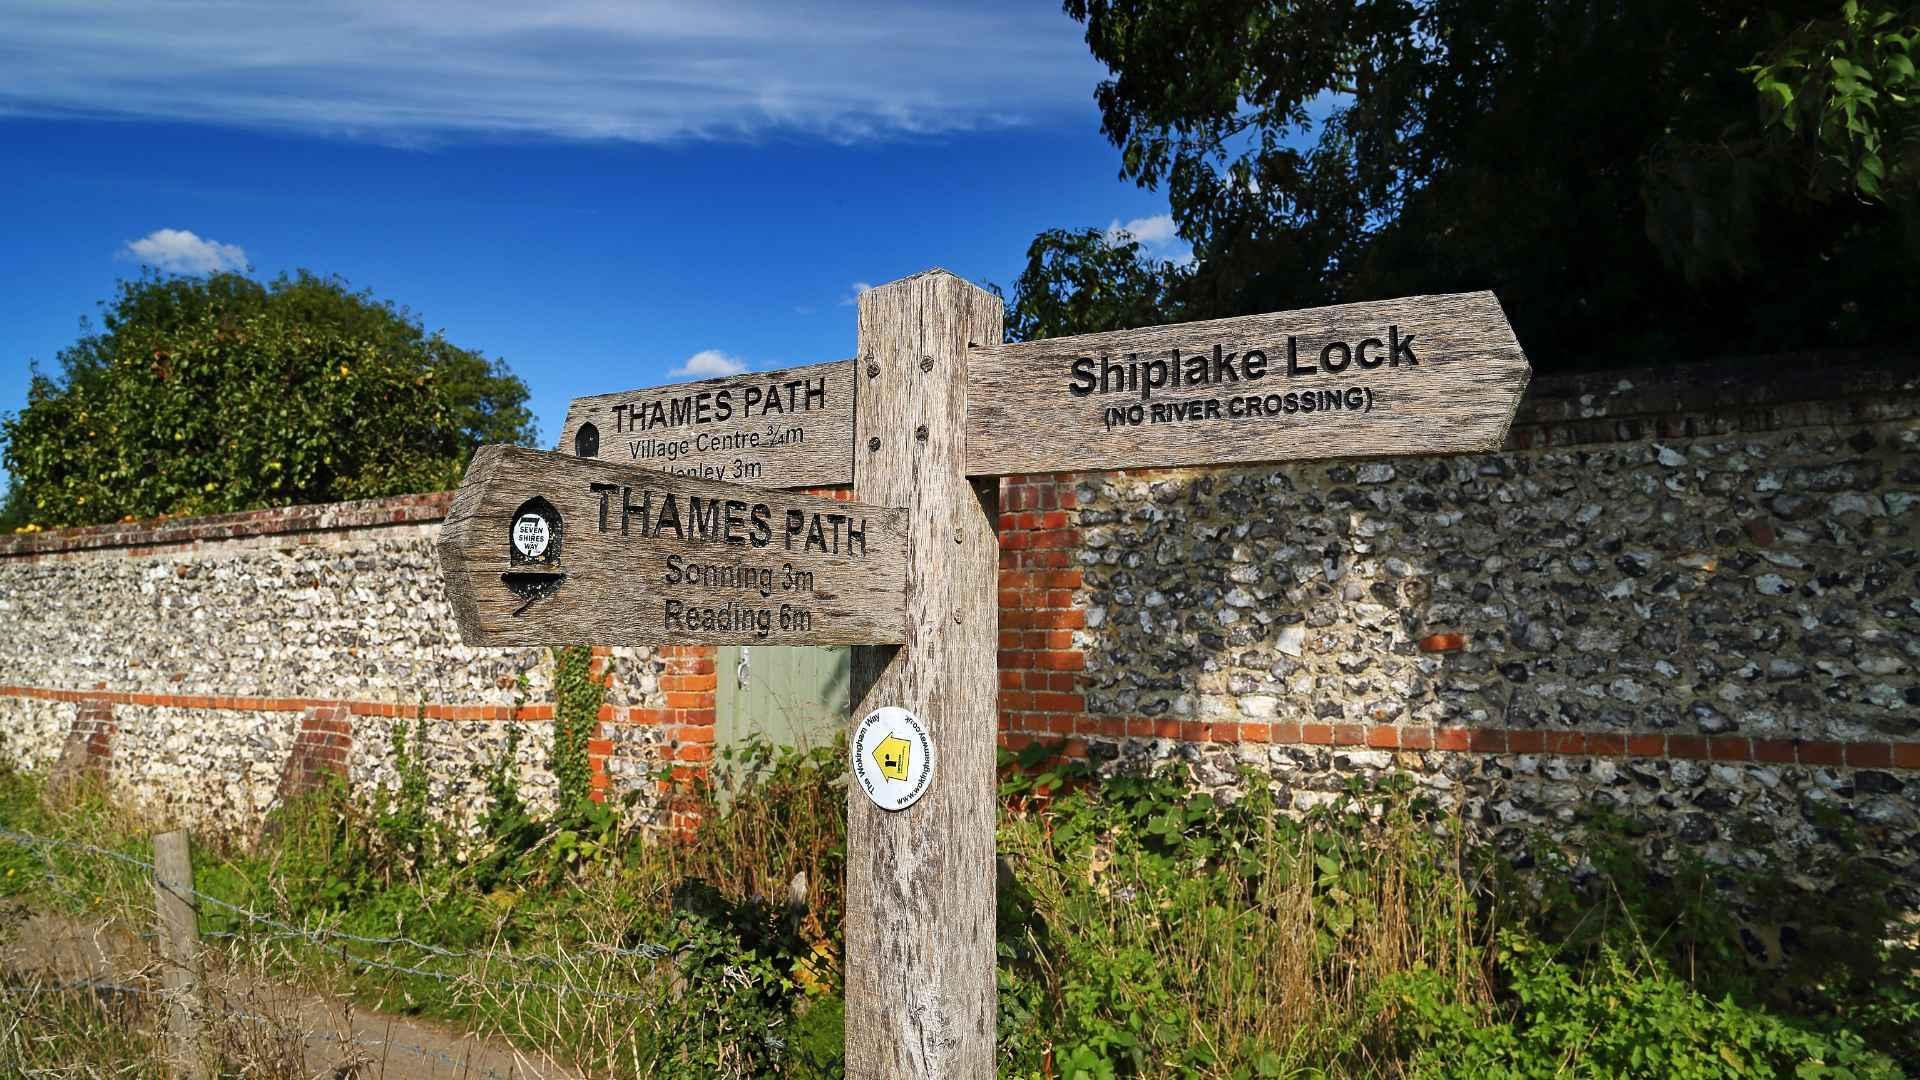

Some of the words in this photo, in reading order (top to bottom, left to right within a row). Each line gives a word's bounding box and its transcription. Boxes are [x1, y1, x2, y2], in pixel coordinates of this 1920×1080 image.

[1069, 343, 1268, 400] Shiplake
[1287, 325, 1419, 377] Lock
[612, 390, 732, 433] THAMES
[744, 377, 825, 418] PATH
[1104, 405, 1145, 432] (NO
[1150, 398, 1221, 424] RIVER
[1227, 386, 1373, 418] CROSSING)
[629, 440, 689, 461] Village
[696, 430, 760, 451] Centre
[733, 459, 762, 479] 3m
[518, 534, 545, 542] SHIRES
[519, 526, 543, 534] SEVEN
[590, 482, 772, 548] THAMES
[785, 509, 867, 557] PATH
[665, 554, 773, 598] Sonning
[781, 562, 814, 592] 3m
[664, 600, 772, 639] Reading
[779, 603, 812, 632] 6m
[864, 712, 880, 727] Way
[855, 727, 868, 778] Wokingham
[864, 777, 875, 796] The
